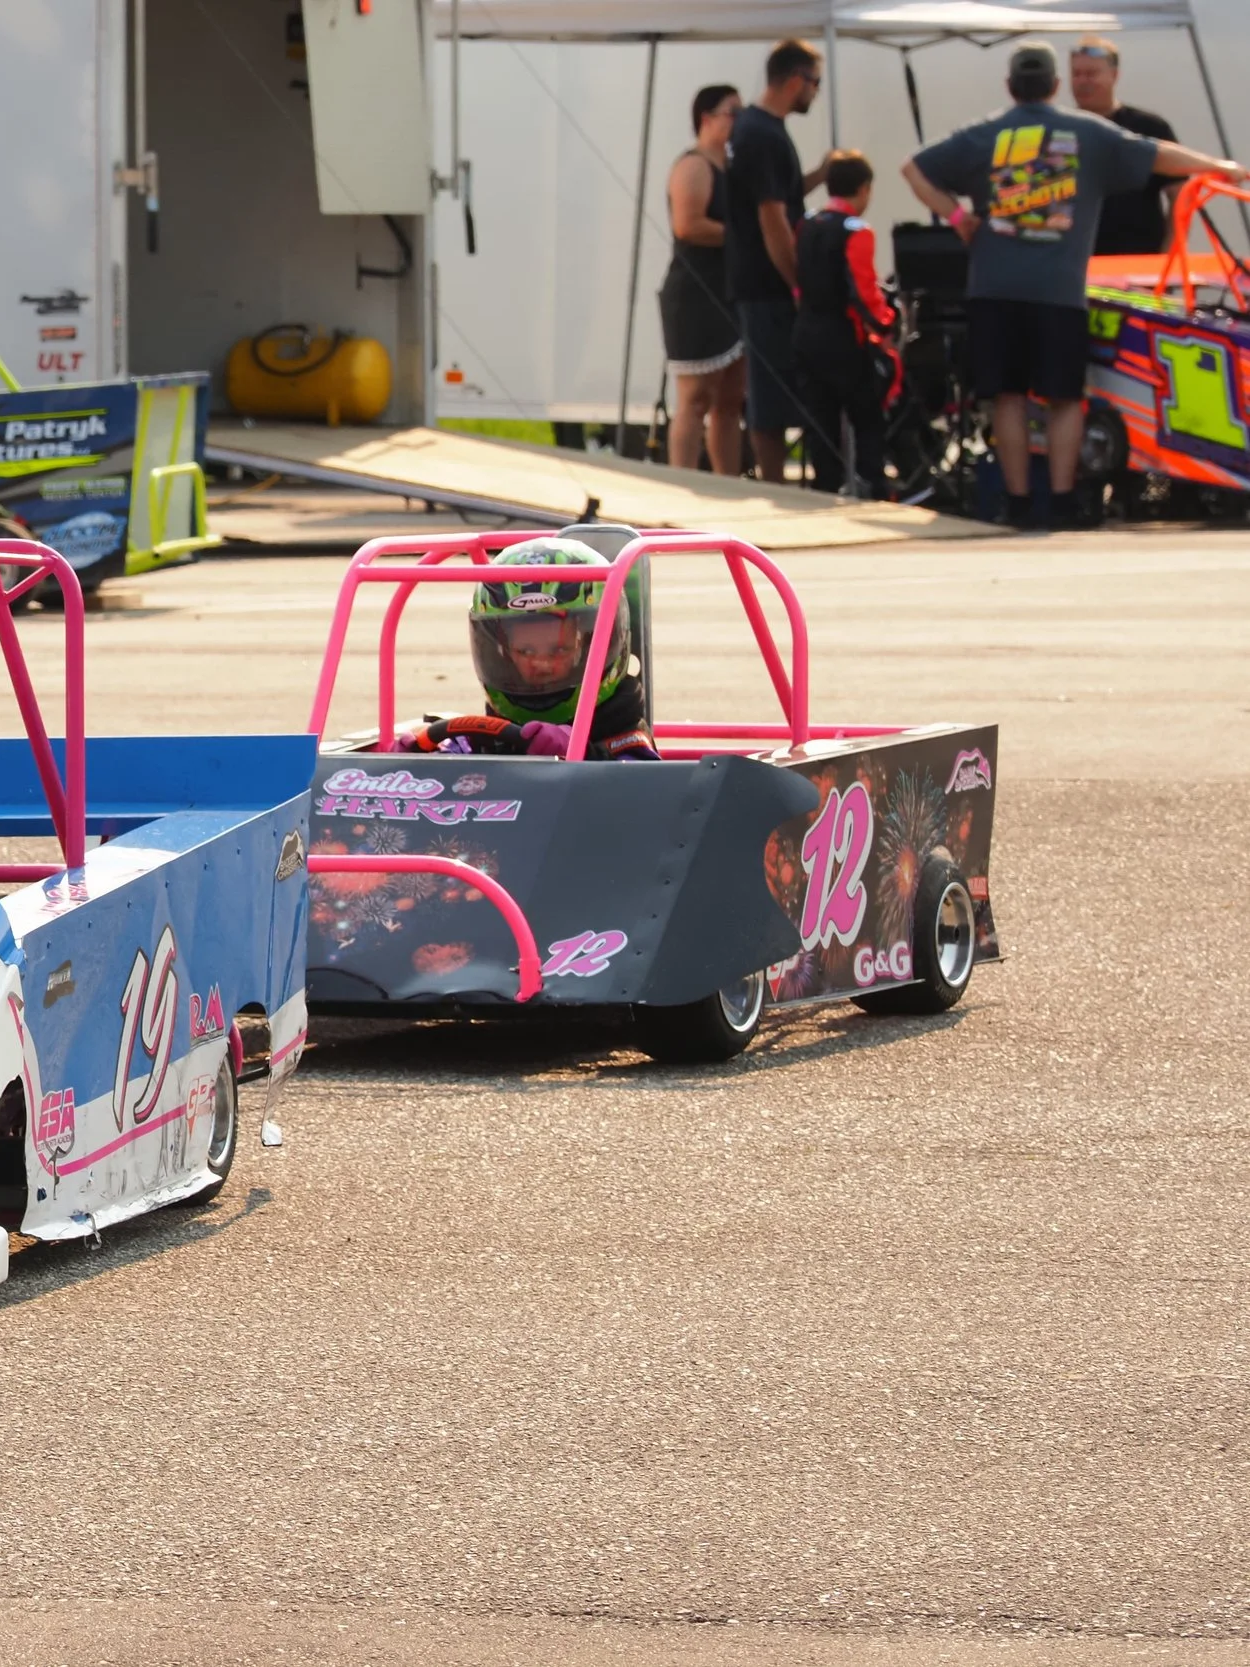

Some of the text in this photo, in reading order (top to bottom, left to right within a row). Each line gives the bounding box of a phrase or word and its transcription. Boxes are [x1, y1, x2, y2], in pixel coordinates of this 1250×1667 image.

[5, 415, 106, 442] Patryk
[323, 768, 445, 799] Emilee
[315, 796, 522, 826] HARTZ
[801, 780, 874, 951] 12
[542, 930, 628, 977] 12
[853, 941, 913, 987] G&G
[112, 922, 179, 1134] 19
